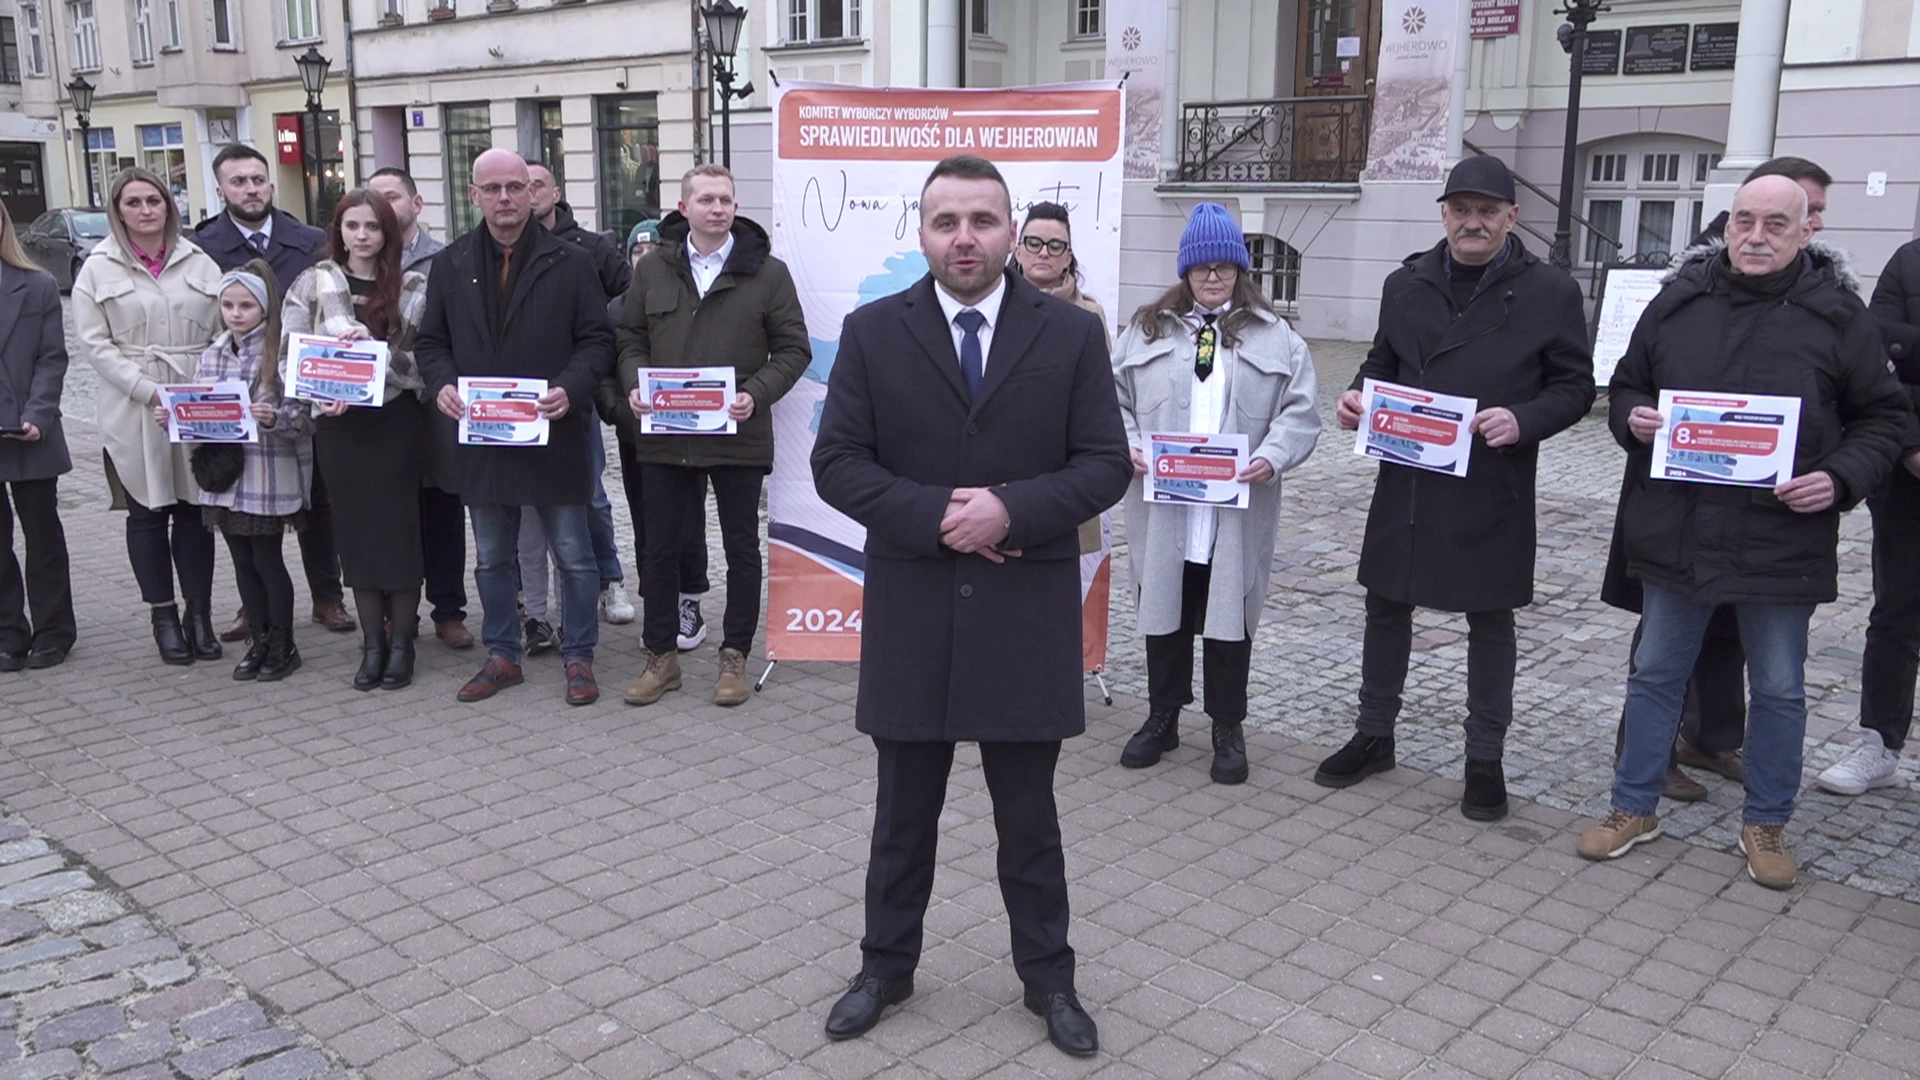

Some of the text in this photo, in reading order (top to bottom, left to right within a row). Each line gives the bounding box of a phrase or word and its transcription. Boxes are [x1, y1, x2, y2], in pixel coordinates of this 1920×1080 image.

[1385, 40, 1448, 53] WEJHEROWO
[799, 105, 949, 121] KOMITET WYBORCZY WYBORCÓW
[799, 122, 1099, 149] SPRAWIEDLIWOŚĆ DLA WEJHEROWIAN
[802, 170, 888, 232] Nowa
[302, 361, 317, 374] 2.
[655, 395, 670, 407] 4.
[177, 406, 191, 417] 1.
[472, 403, 486, 417] 3.
[1378, 413, 1392, 429] 7.
[1676, 427, 1697, 444] 8.
[1158, 459, 1174, 473] 6.
[786, 608, 863, 632] 2024
